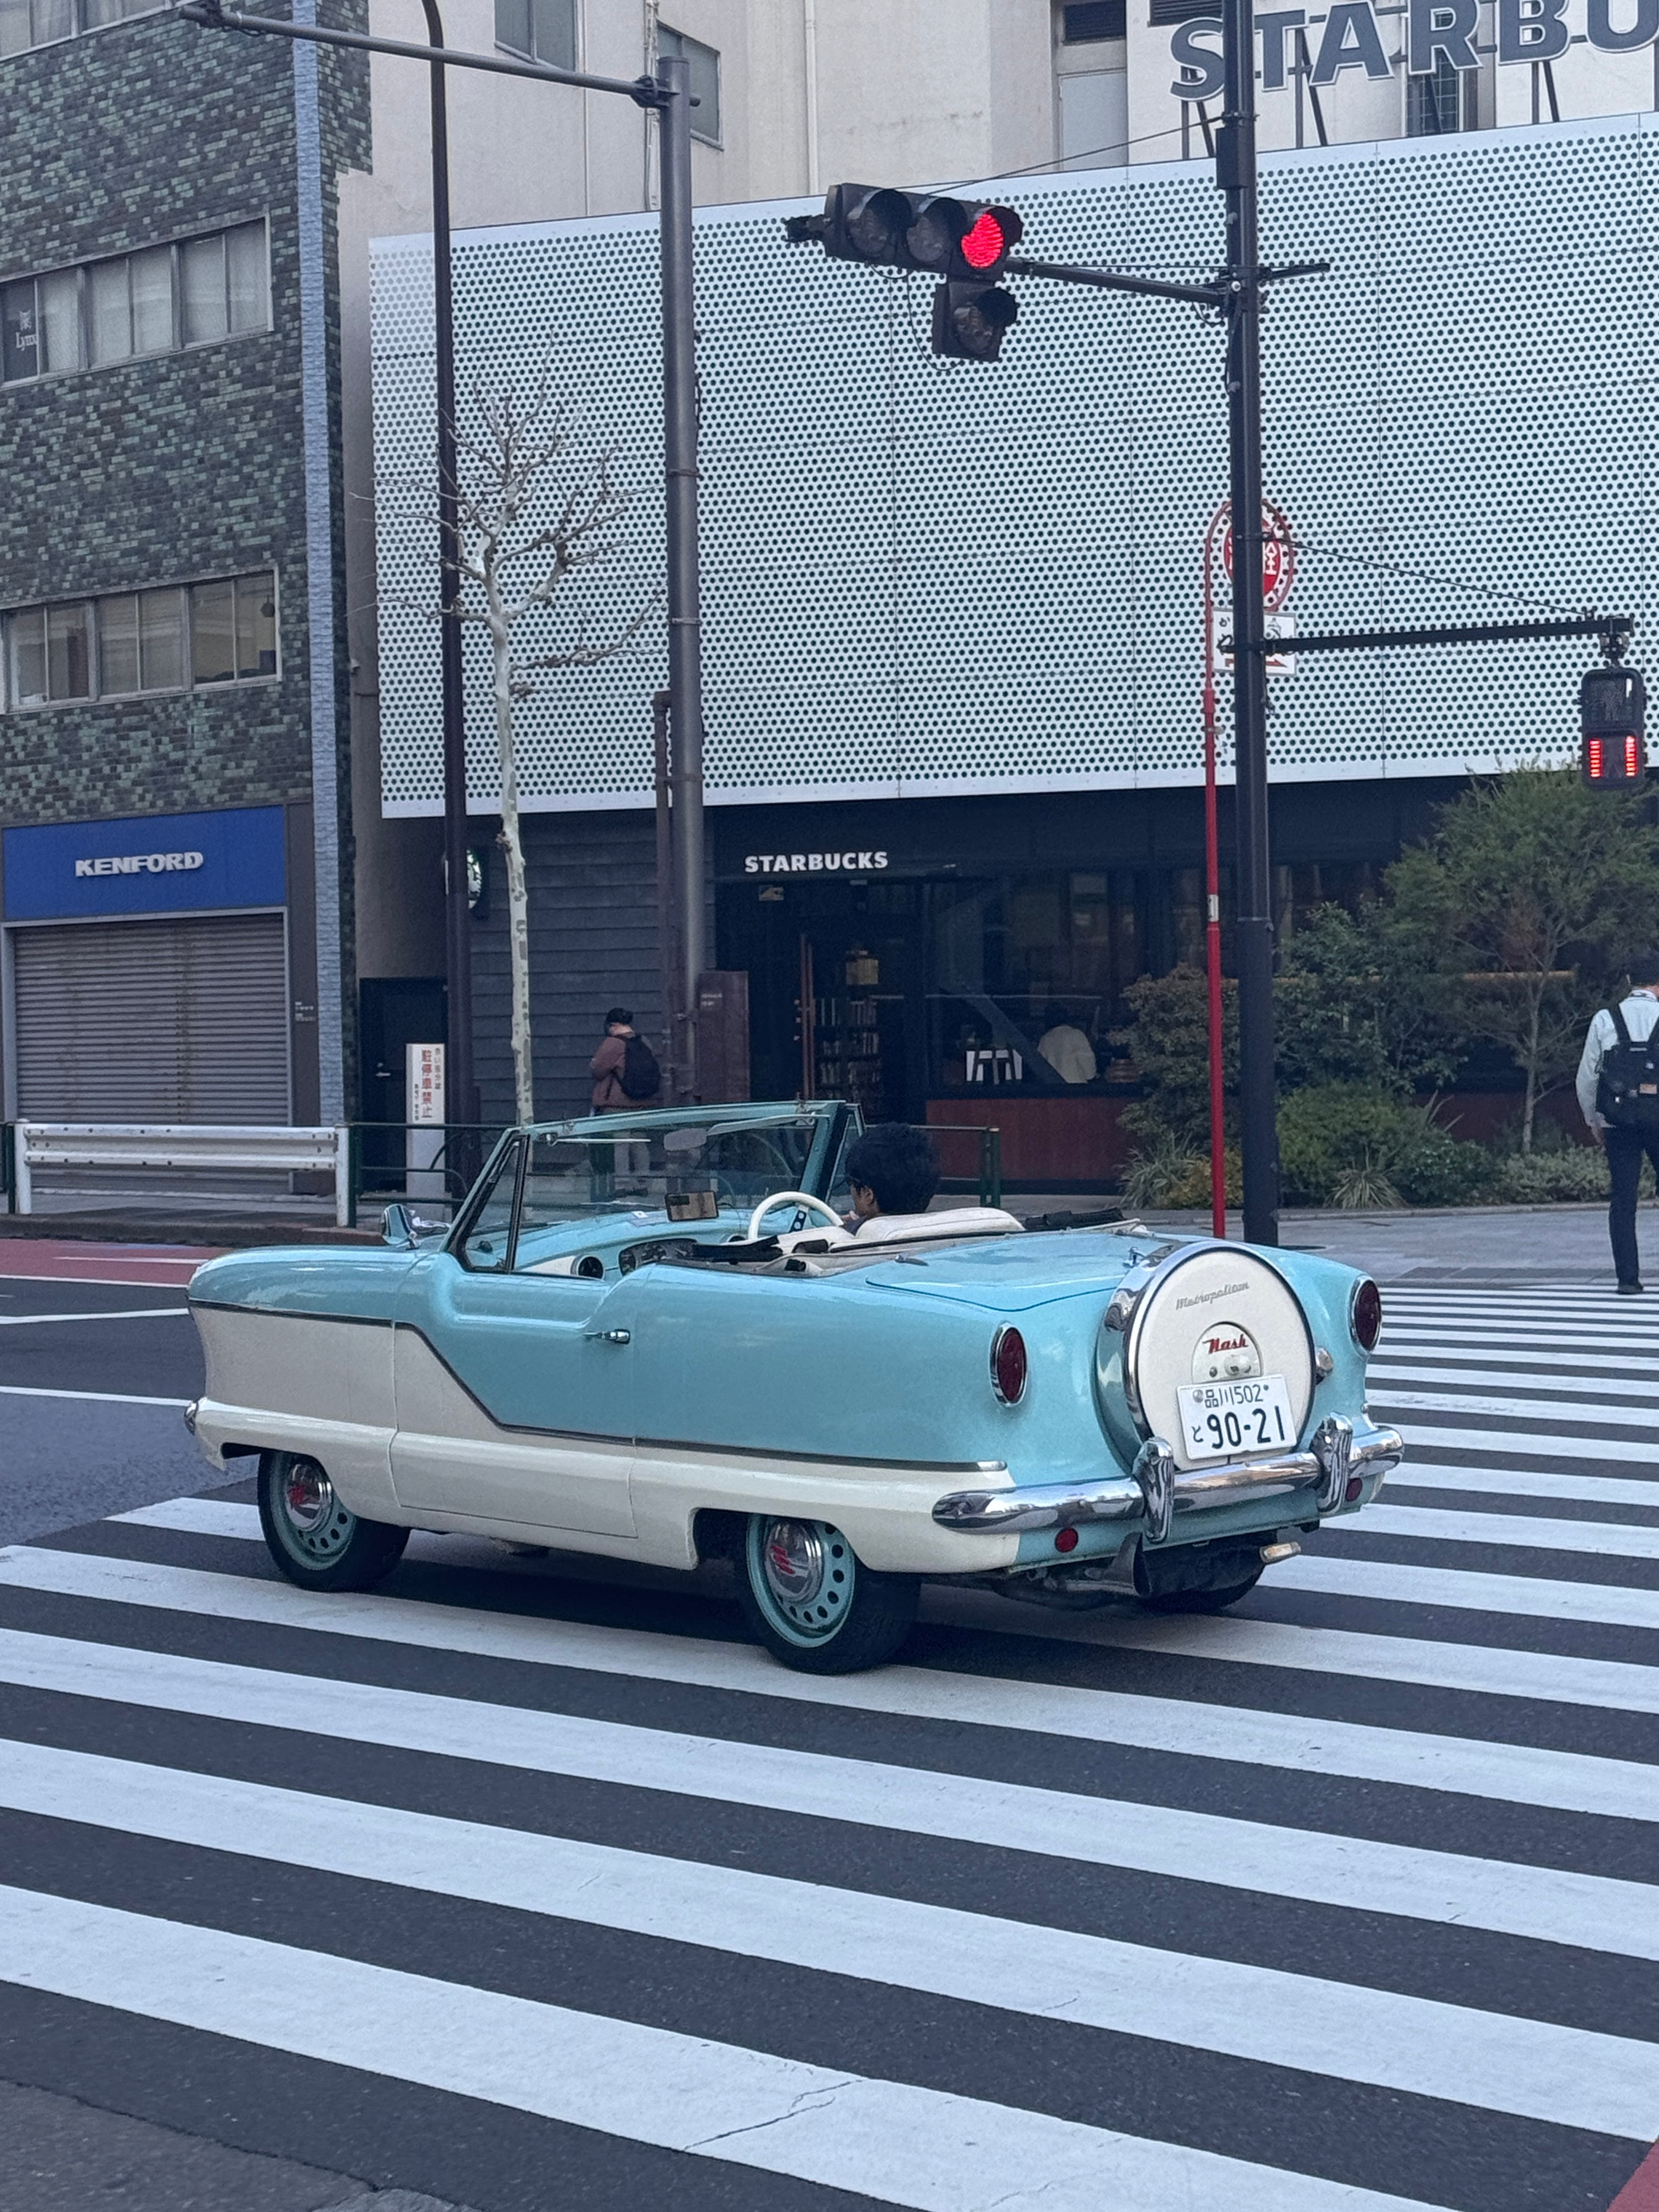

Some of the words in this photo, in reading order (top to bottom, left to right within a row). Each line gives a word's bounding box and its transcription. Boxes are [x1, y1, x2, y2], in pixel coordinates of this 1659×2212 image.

[1170, 0, 1659, 101] STARBU
[75, 851, 204, 877] KENFORD
[744, 851, 888, 872] STARBUCKS
[1176, 1282, 1250, 1310] Metropolitan
[1201, 1333, 1249, 1355] Nash
[1191, 1425, 1204, 1443] と
[1206, 1405, 1285, 1449] 90-21
